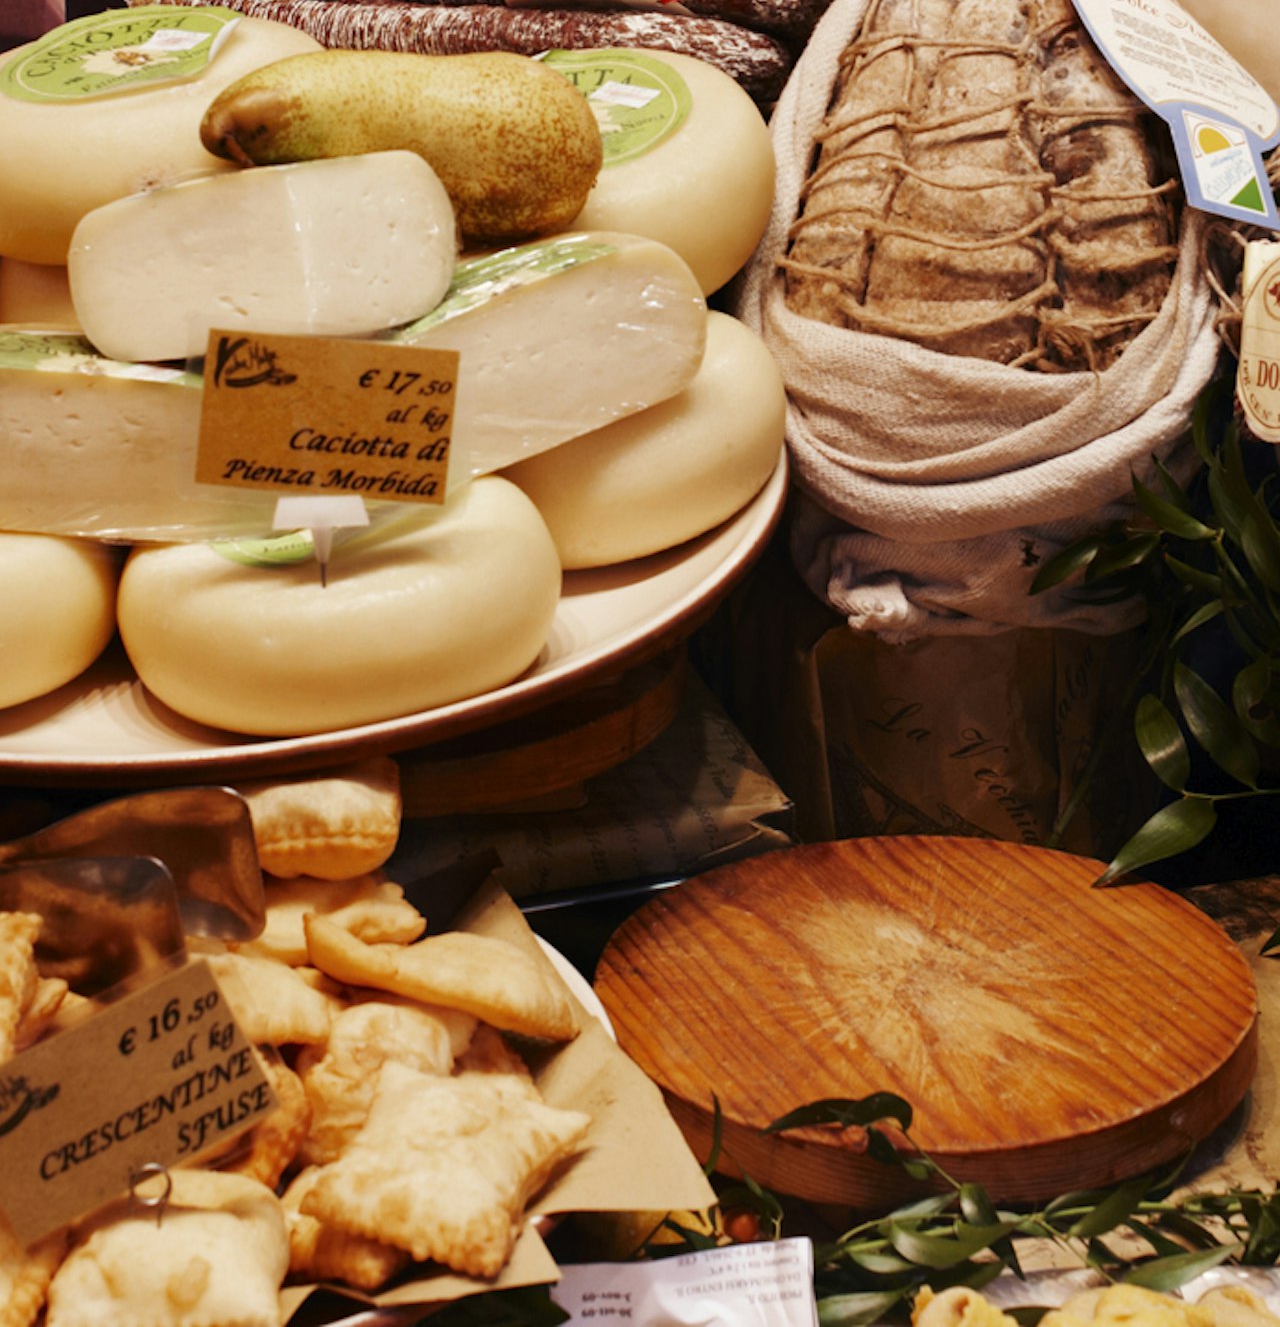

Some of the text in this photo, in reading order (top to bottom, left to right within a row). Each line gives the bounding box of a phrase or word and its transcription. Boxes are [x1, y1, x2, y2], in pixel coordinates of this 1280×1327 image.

[359, 369, 380, 389] €
[386, 405, 450, 433] al kg
[289, 428, 451, 463] Caciotta di
[222, 459, 439, 498] Pienza Morbida
[117, 1026, 138, 1057] €
[172, 1022, 236, 1071] al kg
[38, 1046, 254, 1182] CRESCENTINE
[175, 1080, 272, 1156] SFUSE
